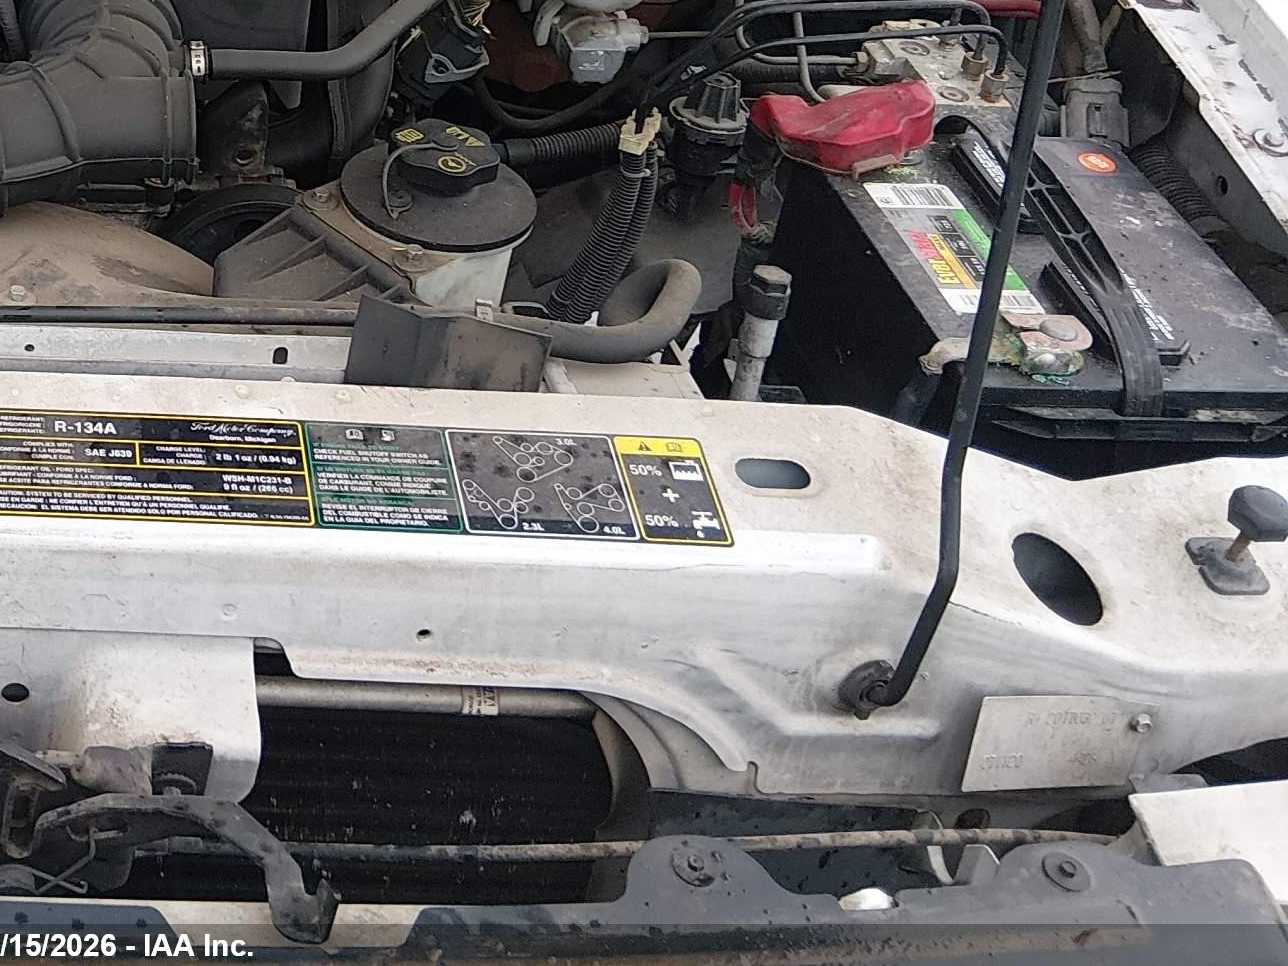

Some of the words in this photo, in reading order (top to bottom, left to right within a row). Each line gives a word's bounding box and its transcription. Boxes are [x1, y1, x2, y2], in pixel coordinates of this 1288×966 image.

[54, 420, 116, 434] R-134A
[190, 421, 216, 431] Ford
[212, 422, 245, 434] Motor
[209, 434, 243, 442] Dearborn,
[555, 438, 577, 446] 3.0L
[84, 448, 106, 456] SAE
[108, 449, 132, 457] J639
[259, 455, 280, 463] (0.94
[281, 456, 297, 465] kg)
[629, 464, 662, 476] 50%
[278, 486, 293, 494] cc)
[645, 514, 679, 527] 50%
[522, 522, 545, 531] 2.3L
